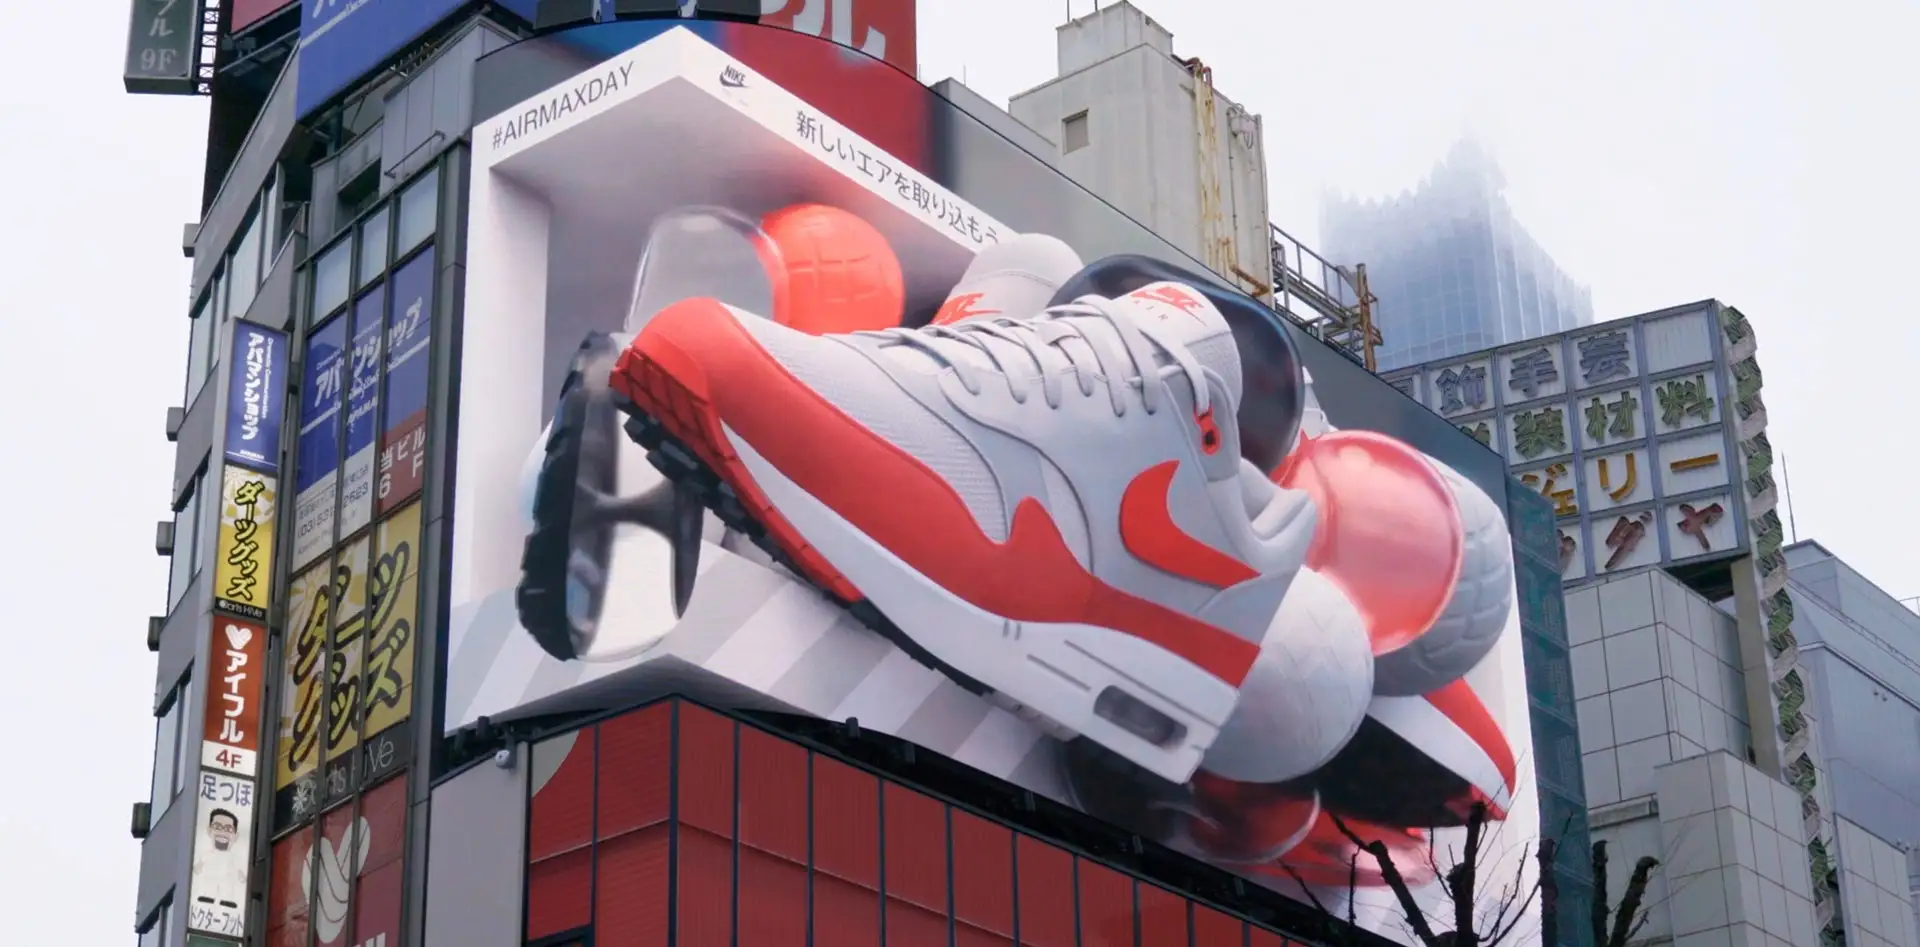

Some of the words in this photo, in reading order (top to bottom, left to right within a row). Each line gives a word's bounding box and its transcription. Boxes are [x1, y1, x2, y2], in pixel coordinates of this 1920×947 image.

[141, 48, 177, 72] 9F
[492, 60, 634, 150] #AIRMAXDAY
[241, 332, 265, 440] アパマンショップ
[379, 473, 391, 499] 6
[412, 450, 424, 478] F
[380, 426, 426, 472] 当ビル
[226, 480, 266, 602] ダーツグッズ
[219, 650, 249, 743] アイフル
[216, 750, 243, 769] 4F
